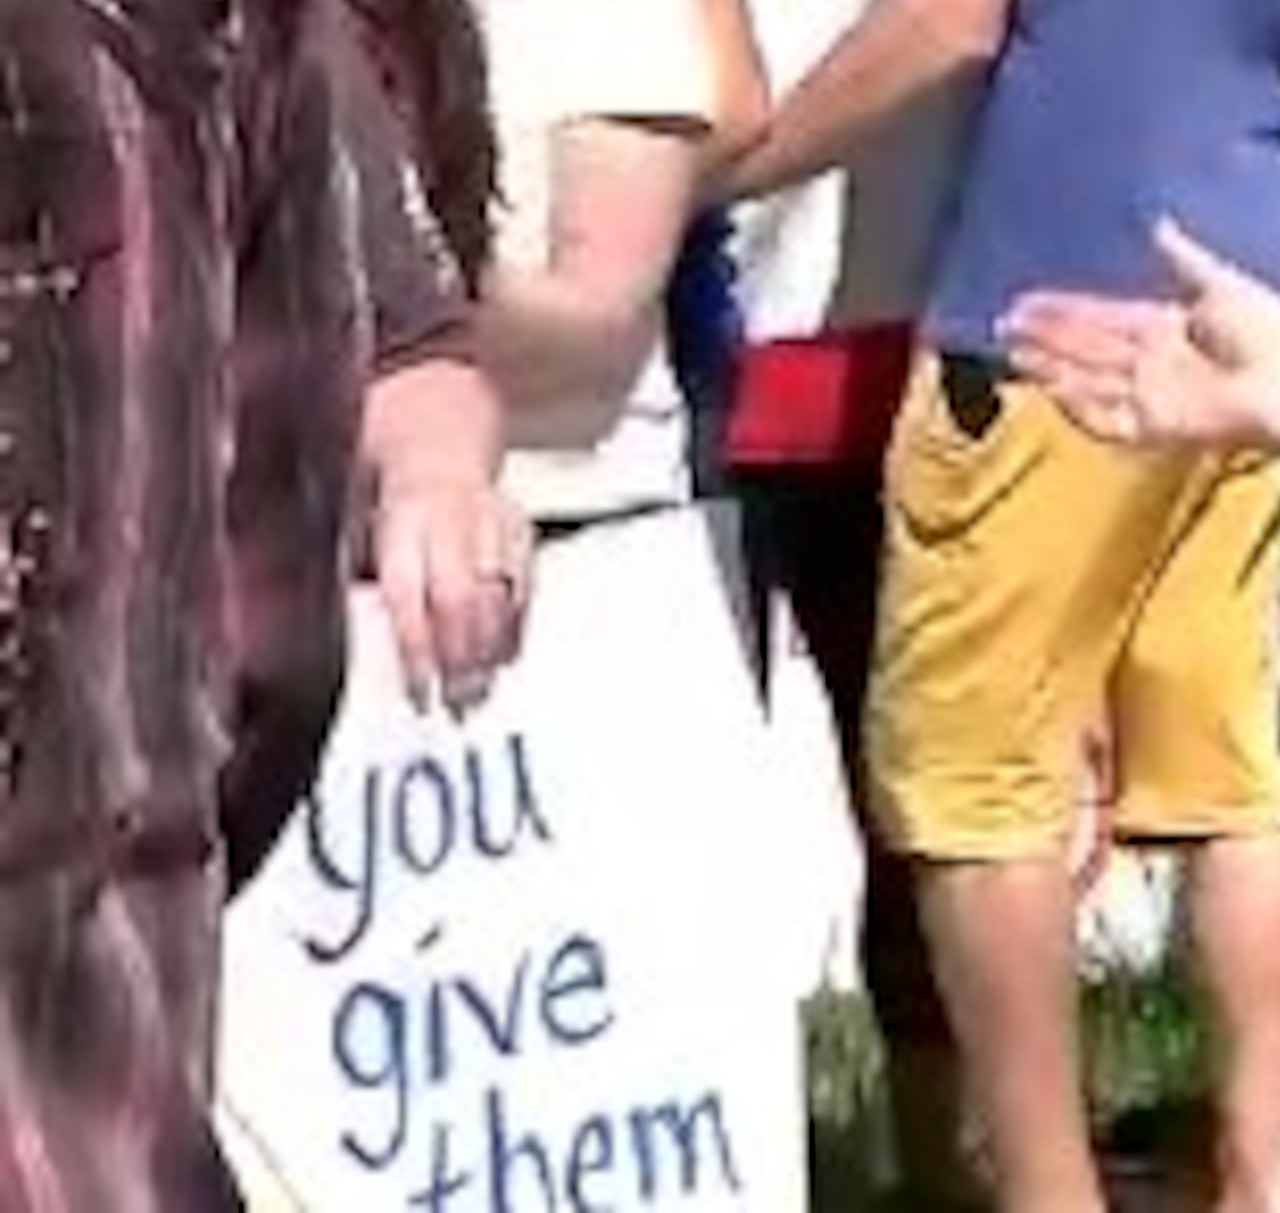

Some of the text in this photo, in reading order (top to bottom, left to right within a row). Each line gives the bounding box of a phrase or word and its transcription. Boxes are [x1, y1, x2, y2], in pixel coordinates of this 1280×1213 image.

[303, 733, 553, 965] you
[332, 922, 615, 1169] give
[408, 1085, 743, 1213] them
